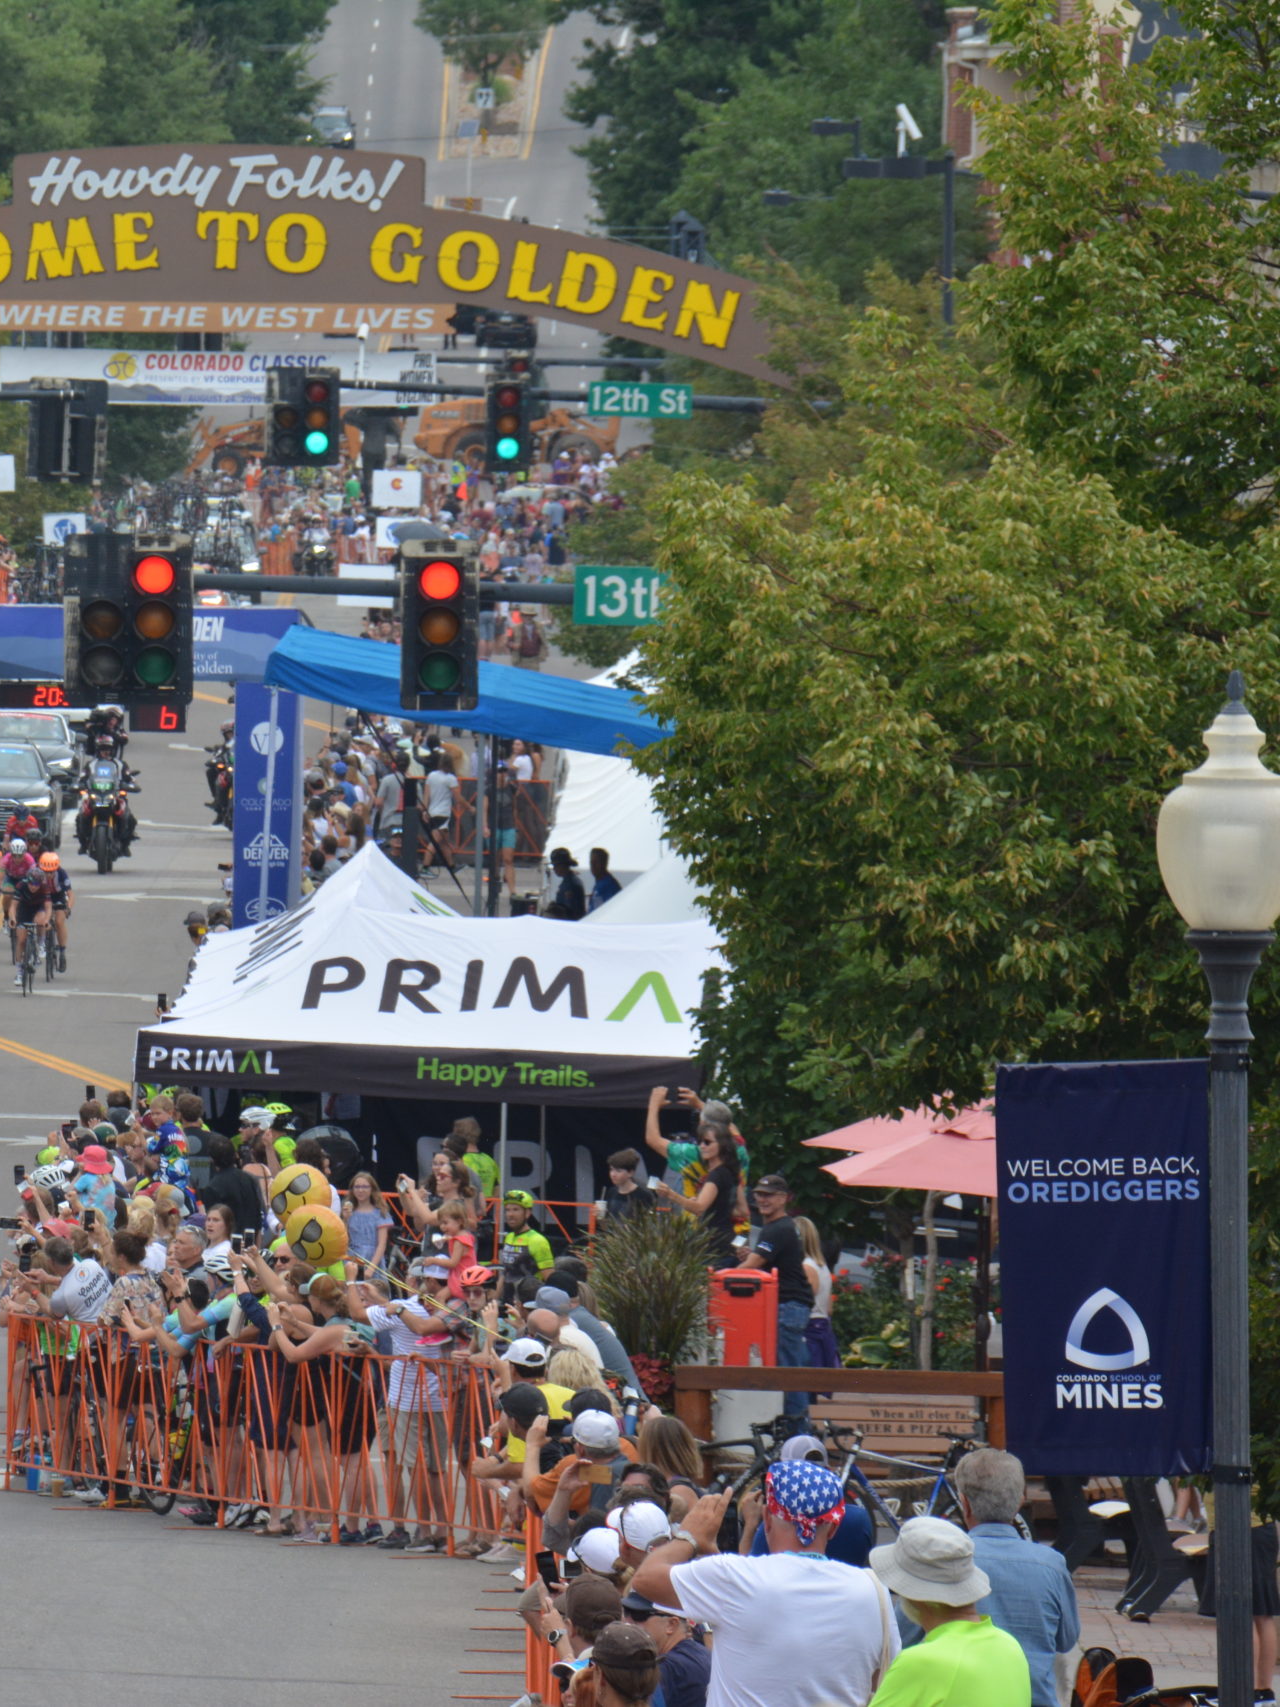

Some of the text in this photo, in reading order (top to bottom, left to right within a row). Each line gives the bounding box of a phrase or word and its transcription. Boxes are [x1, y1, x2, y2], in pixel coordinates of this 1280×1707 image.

[28, 153, 405, 212] Howdy Folks!
[196, 210, 327, 274] TO
[369, 222, 741, 349] GOLDEN
[139, 305, 208, 328] THE
[220, 306, 324, 329] WEST
[332, 308, 435, 330] LIVES
[145, 353, 244, 372] COLORADO
[217, 376, 266, 384] CORPORAT
[592, 385, 688, 414] 12th St
[193, 616, 225, 642] DEN
[33, 686, 70, 706] 20:
[243, 847, 289, 860] DEVER
[301, 956, 683, 1024] PRIMA
[148, 1045, 280, 1075] PRIMAL
[417, 1057, 596, 1088] Happy Trails.
[1007, 1156, 1200, 1177] WELCOME BACK,
[1007, 1178, 1200, 1204] OREDIGGERS
[1056, 1374, 1162, 1383] COLORADO SCHOOL OF
[1056, 1383, 1164, 1409] MINES
[870, 1408, 905, 1419] When
[907, 1408, 924, 1419] all
[928, 1408, 952, 1420] else
